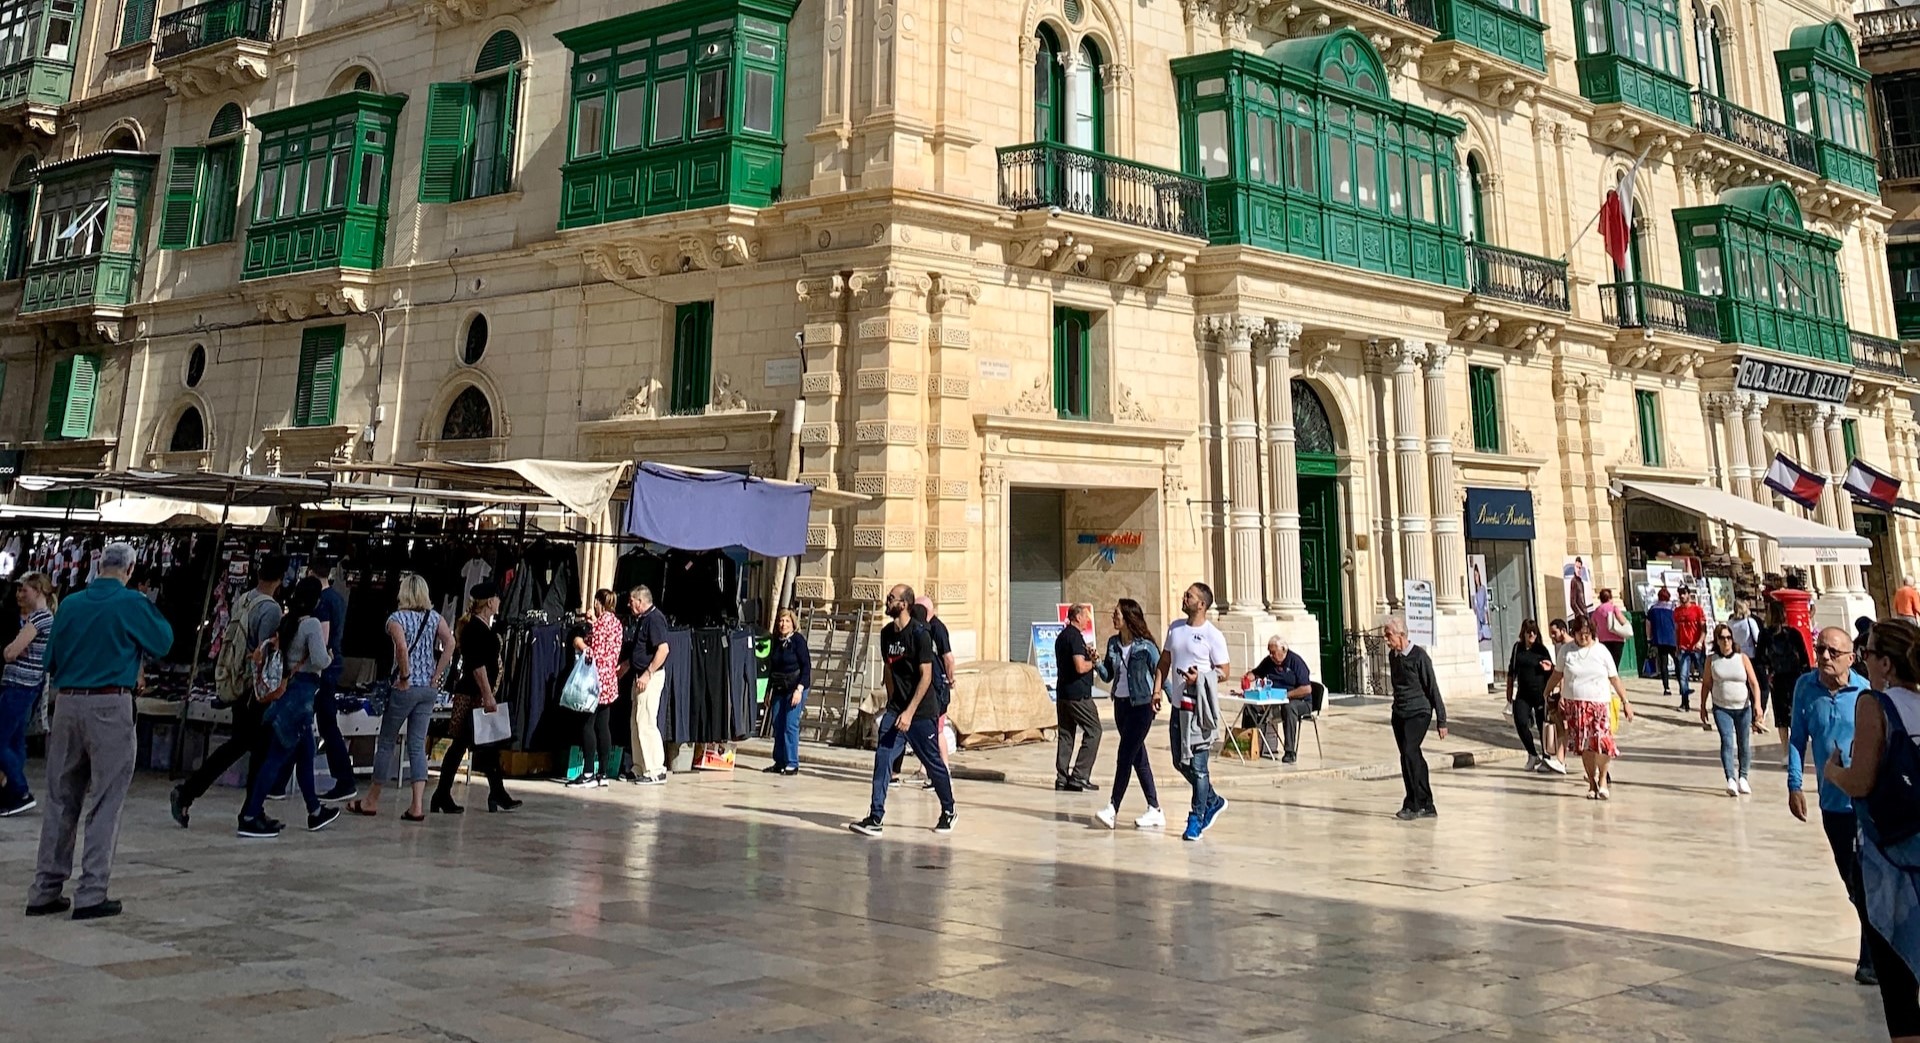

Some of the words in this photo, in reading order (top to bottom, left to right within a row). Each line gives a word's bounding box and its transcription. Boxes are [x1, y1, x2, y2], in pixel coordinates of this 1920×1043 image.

[1766, 365, 1810, 395] BATTA
[1809, 373, 1848, 401] DELIA
[1038, 630, 1062, 639] SICILY
